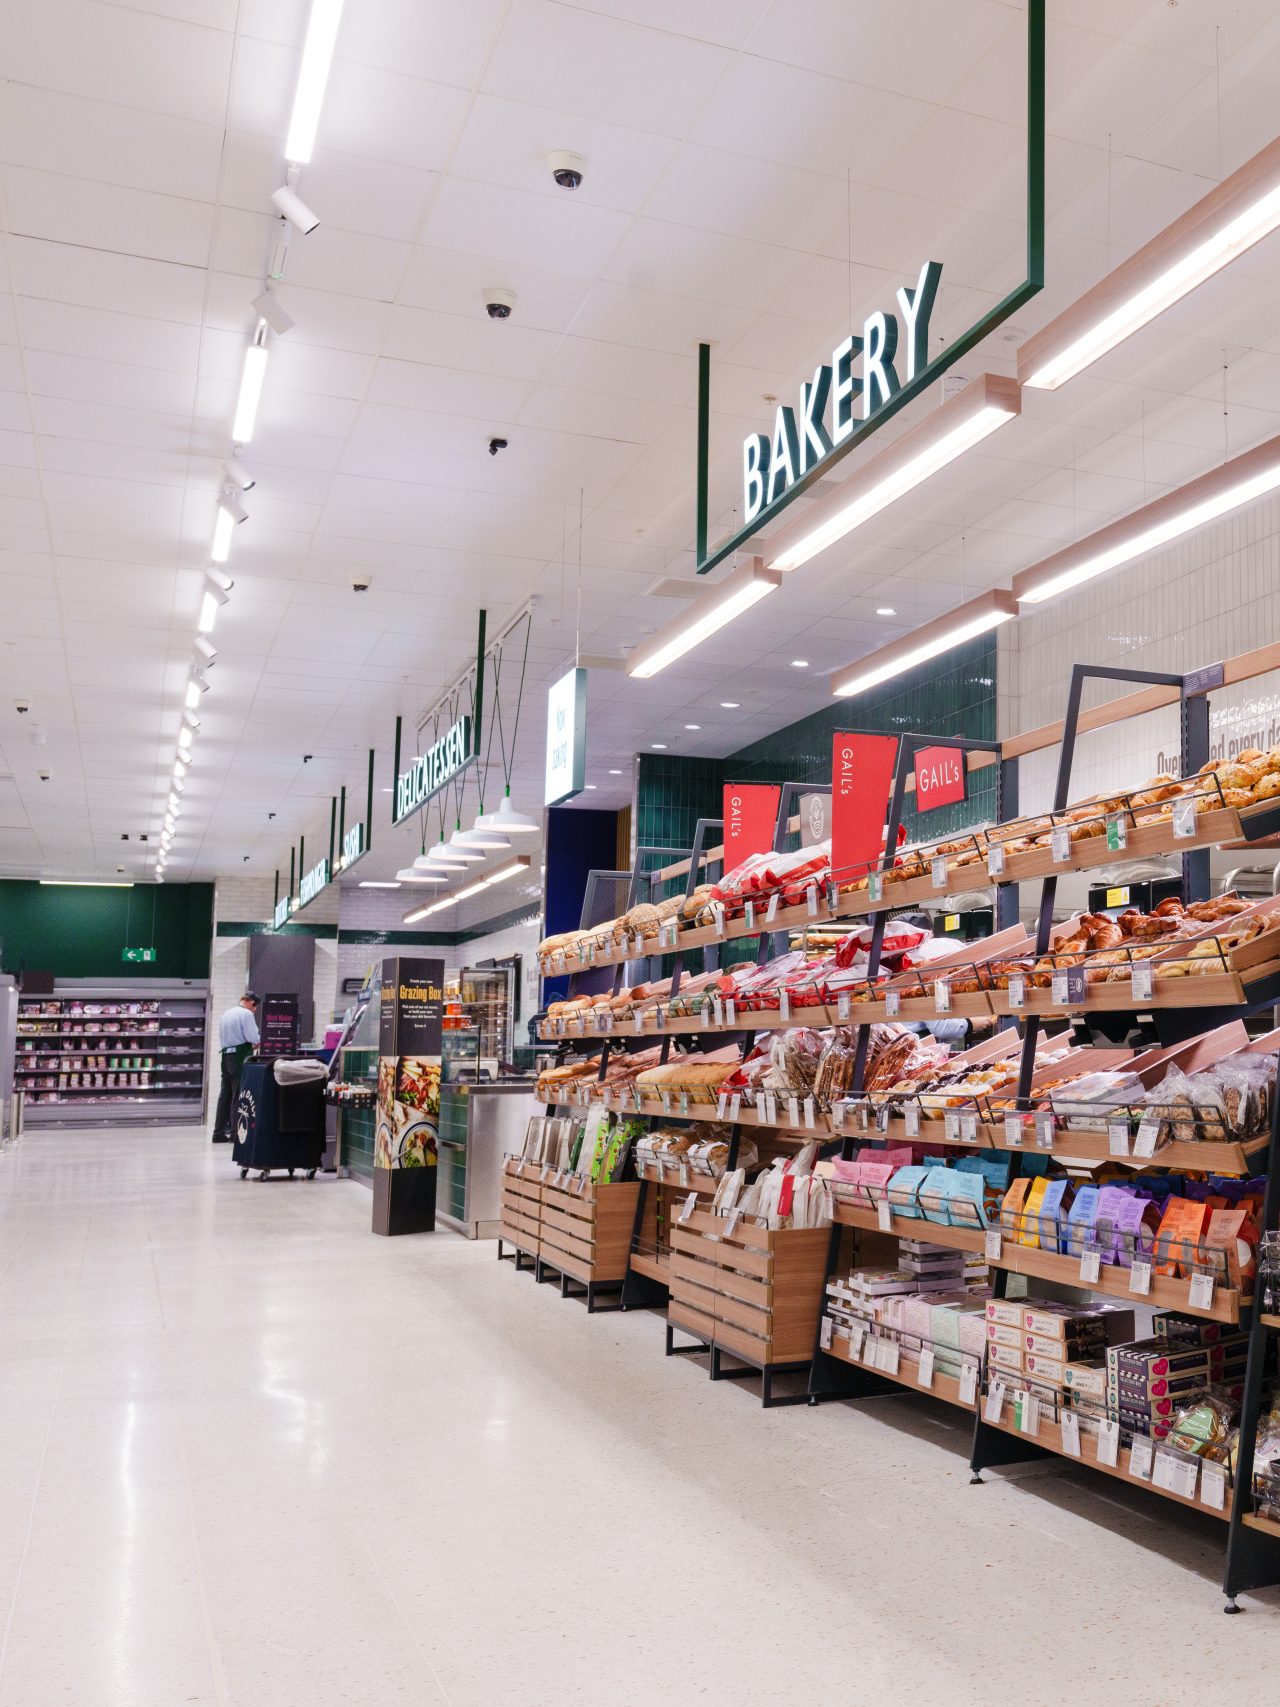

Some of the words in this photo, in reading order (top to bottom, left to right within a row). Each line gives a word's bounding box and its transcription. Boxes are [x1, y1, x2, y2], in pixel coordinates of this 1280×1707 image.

[744, 261, 942, 524] BAKERY
[397, 715, 468, 820] DELICATESSEN
[841, 748, 854, 795] GAIL's
[919, 759, 960, 792] GAIL's
[731, 796, 742, 837] GAIL's
[399, 984, 428, 1003] Grazing
[428, 985, 442, 1001] Box
